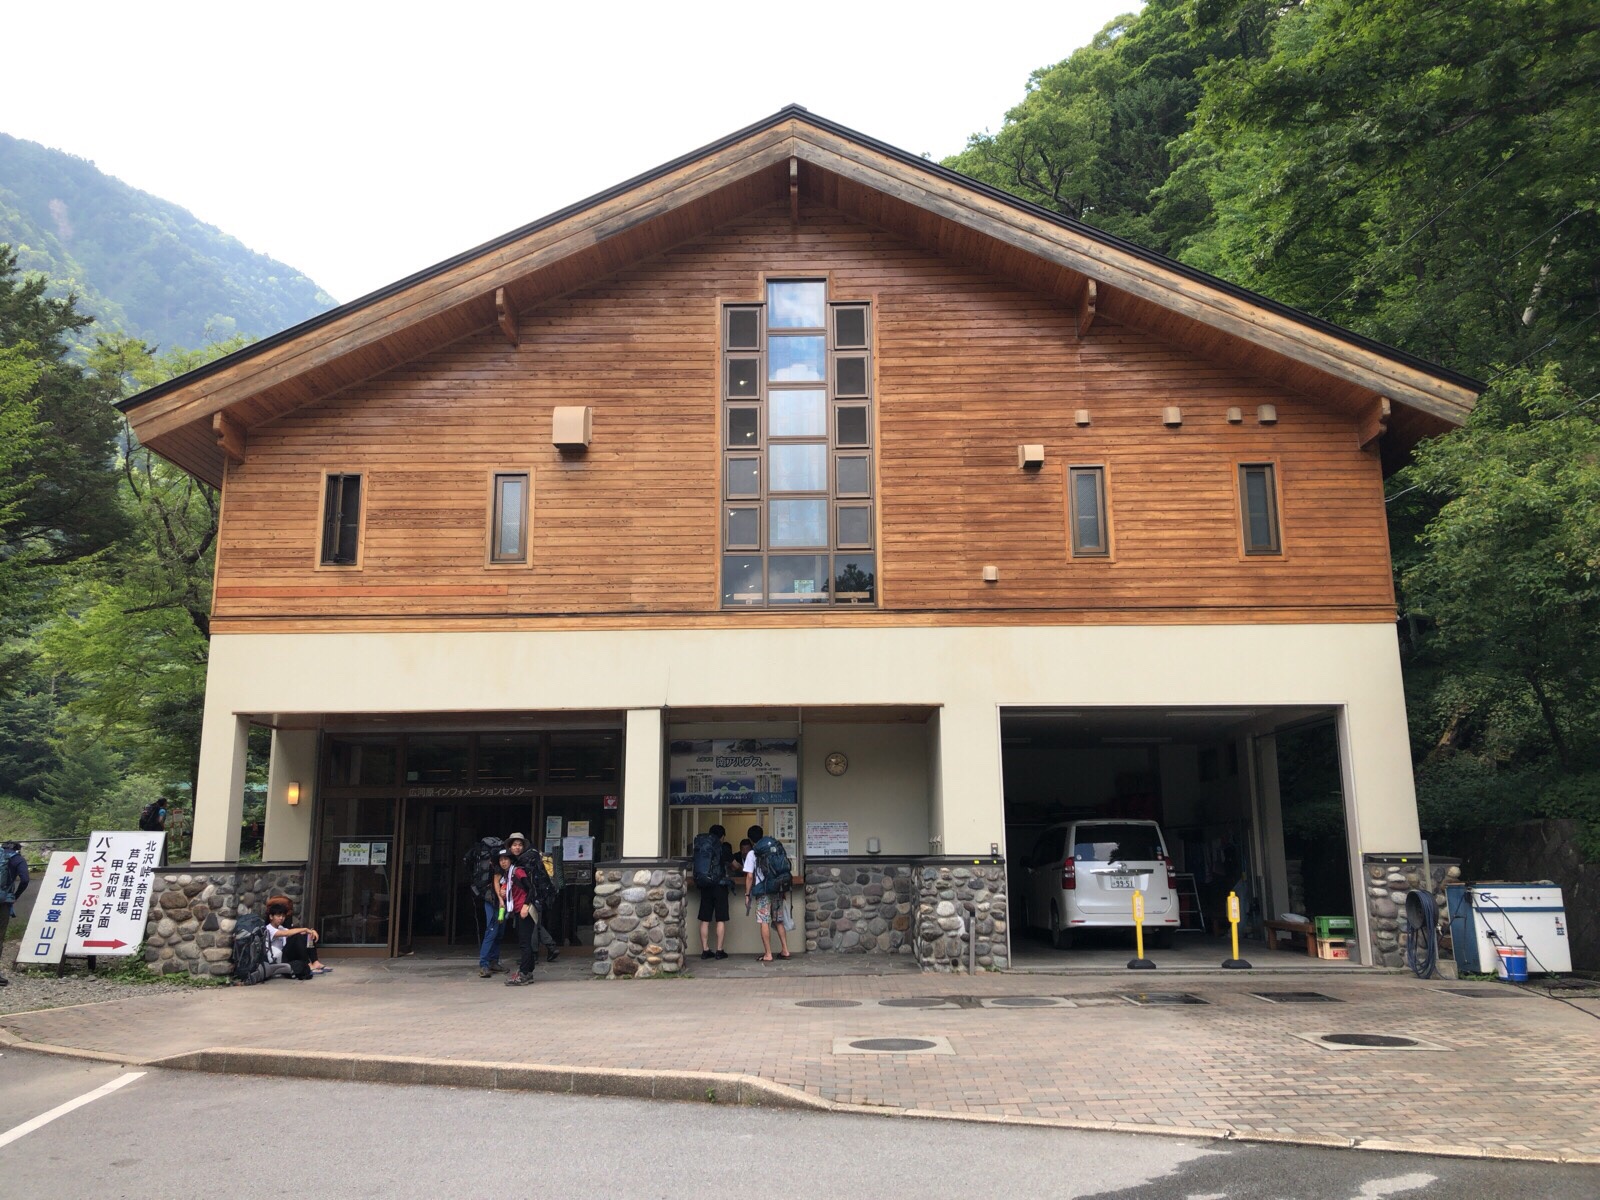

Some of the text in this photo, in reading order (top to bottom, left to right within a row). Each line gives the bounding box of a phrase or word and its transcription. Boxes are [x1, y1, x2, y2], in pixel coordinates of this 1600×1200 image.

[34, 875, 73, 956] 北岳登山口
[75, 836, 113, 938] バスきっぷ売場
[115, 848, 141, 915] 芦安駐車場
[130, 840, 157, 921] 北沢峠・奈良田
